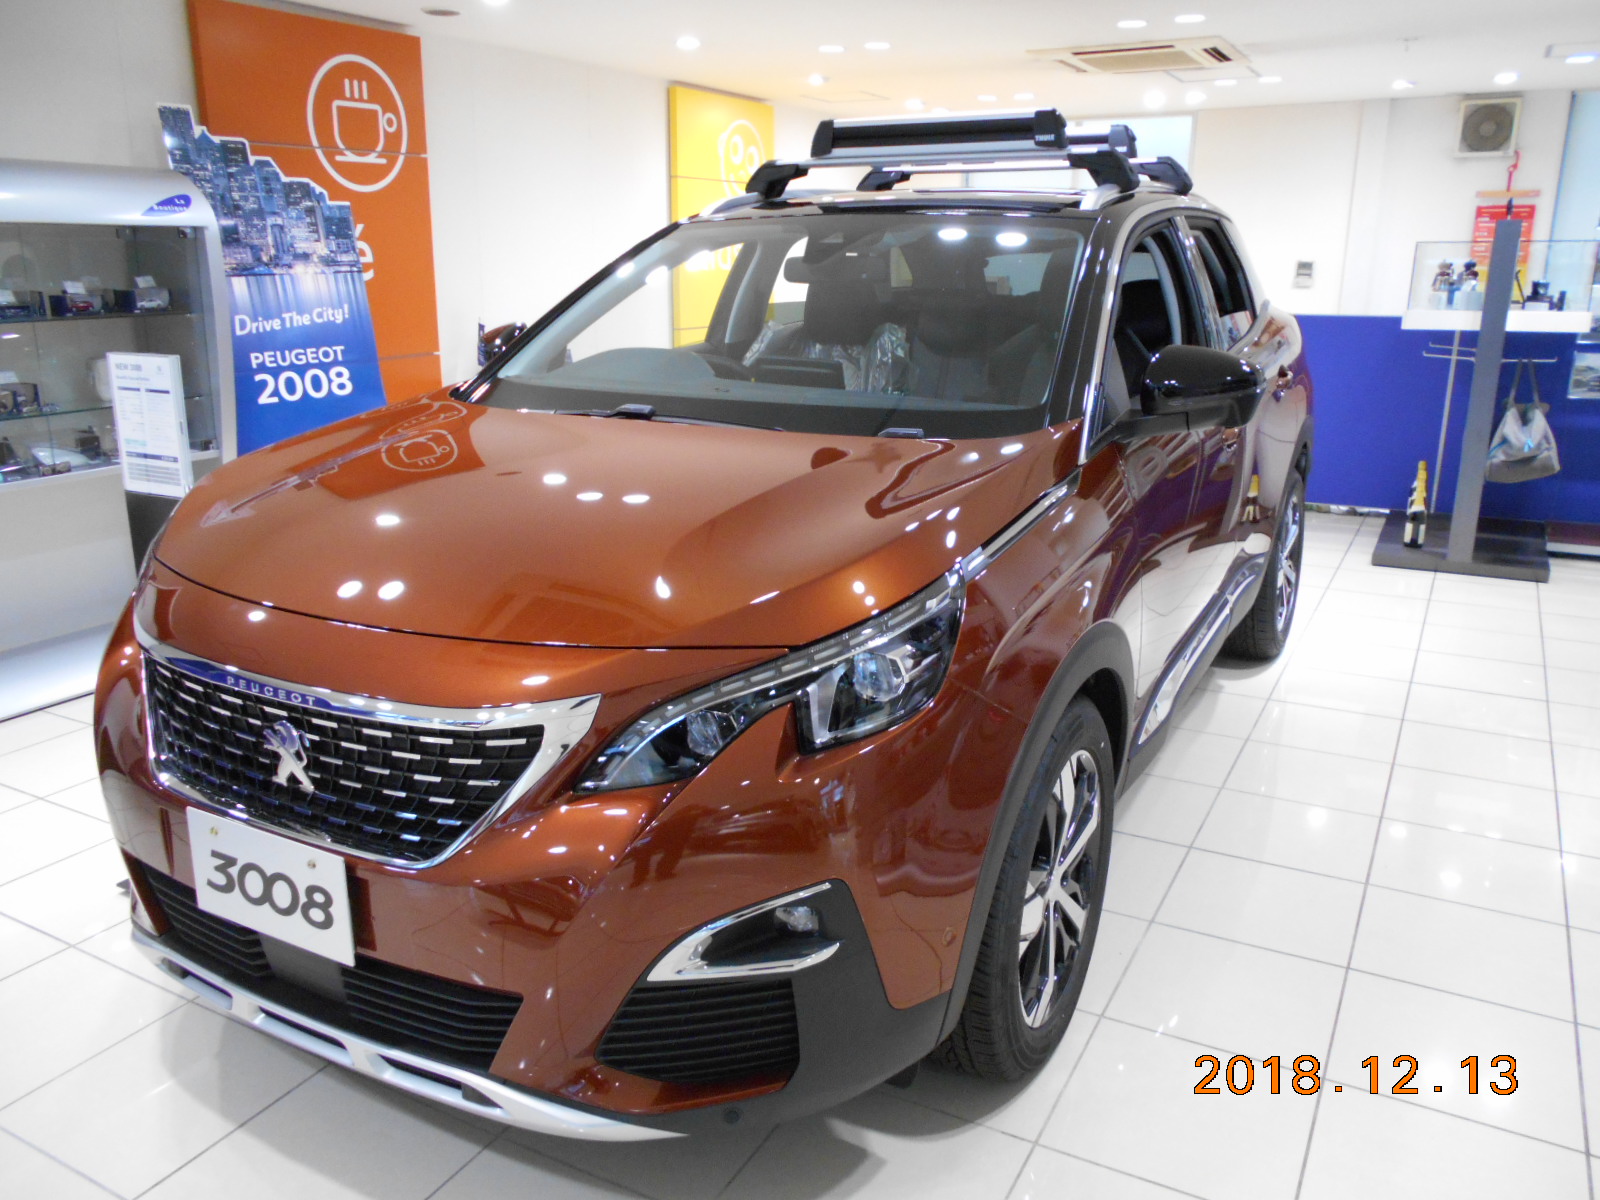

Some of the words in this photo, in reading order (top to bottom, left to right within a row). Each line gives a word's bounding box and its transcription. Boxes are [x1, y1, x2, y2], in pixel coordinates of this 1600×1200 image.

[234, 314, 282, 336] Drive
[282, 310, 311, 328] The
[312, 304, 349, 324] City!
[250, 346, 345, 369] PEUGEOT
[254, 366, 353, 405] 2008
[226, 675, 316, 706] PEUGEOT
[206, 849, 334, 931] 3008
